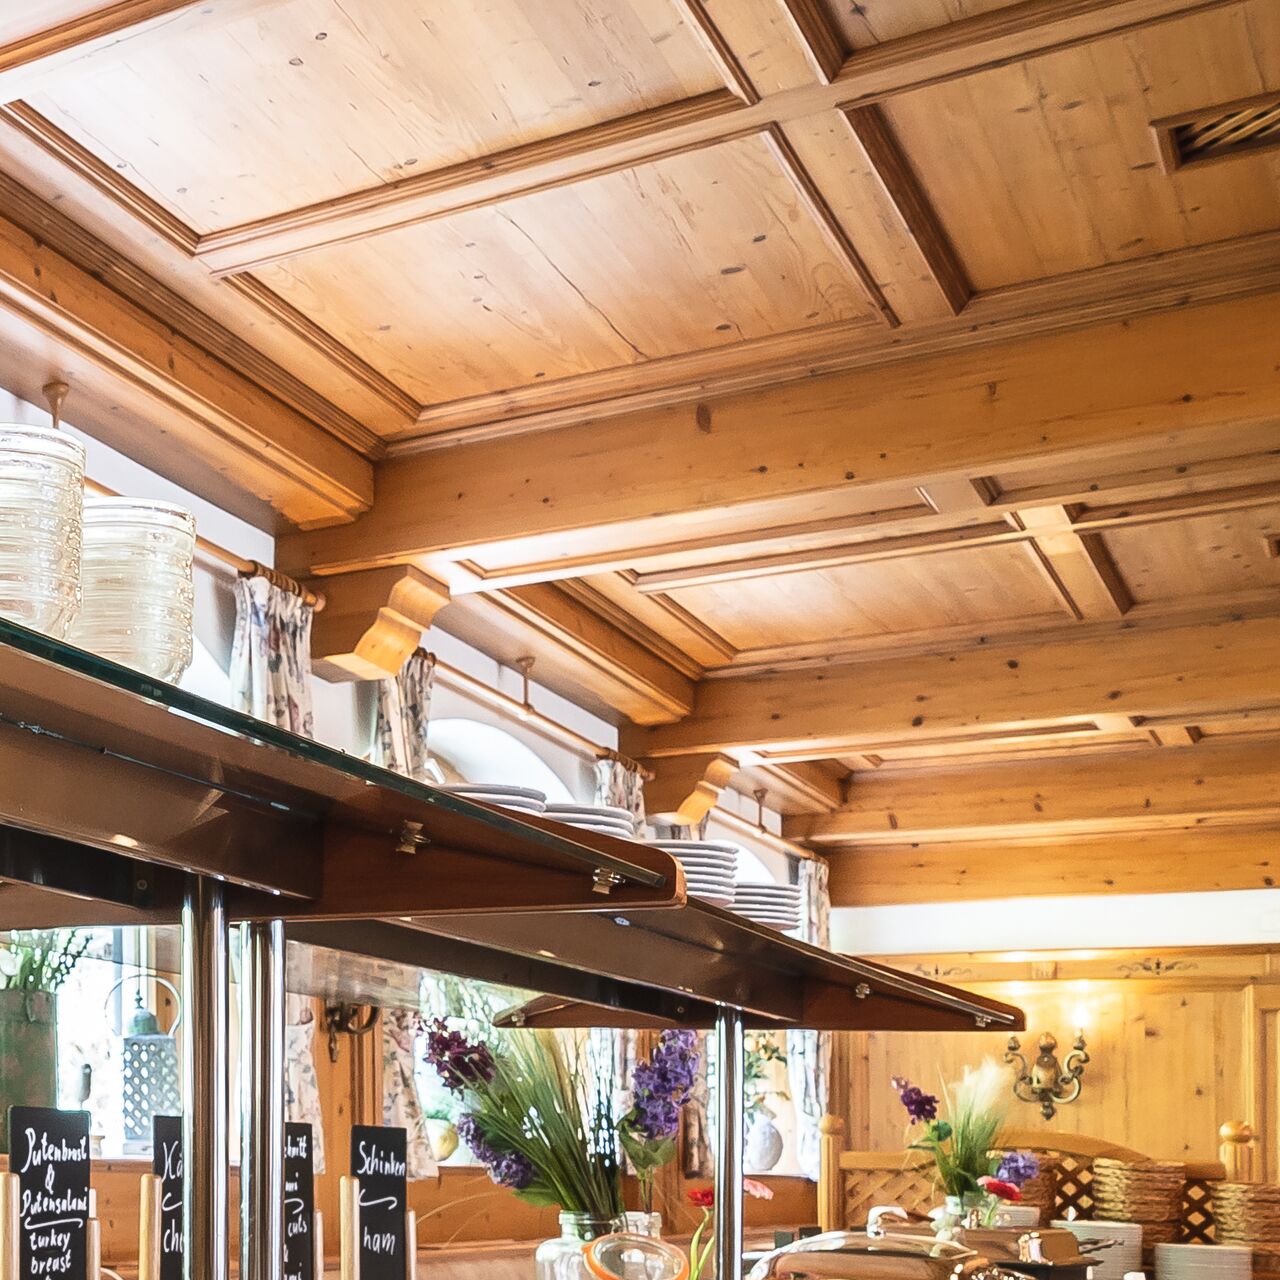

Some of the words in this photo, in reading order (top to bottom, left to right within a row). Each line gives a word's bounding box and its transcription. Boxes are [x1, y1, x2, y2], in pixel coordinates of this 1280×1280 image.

[356, 1140, 407, 1177] Schinken
[44, 1163, 55, 1194] &
[29, 1228, 71, 1252] turkey
[363, 1226, 396, 1255] ham
[31, 1249, 72, 1274] breast
